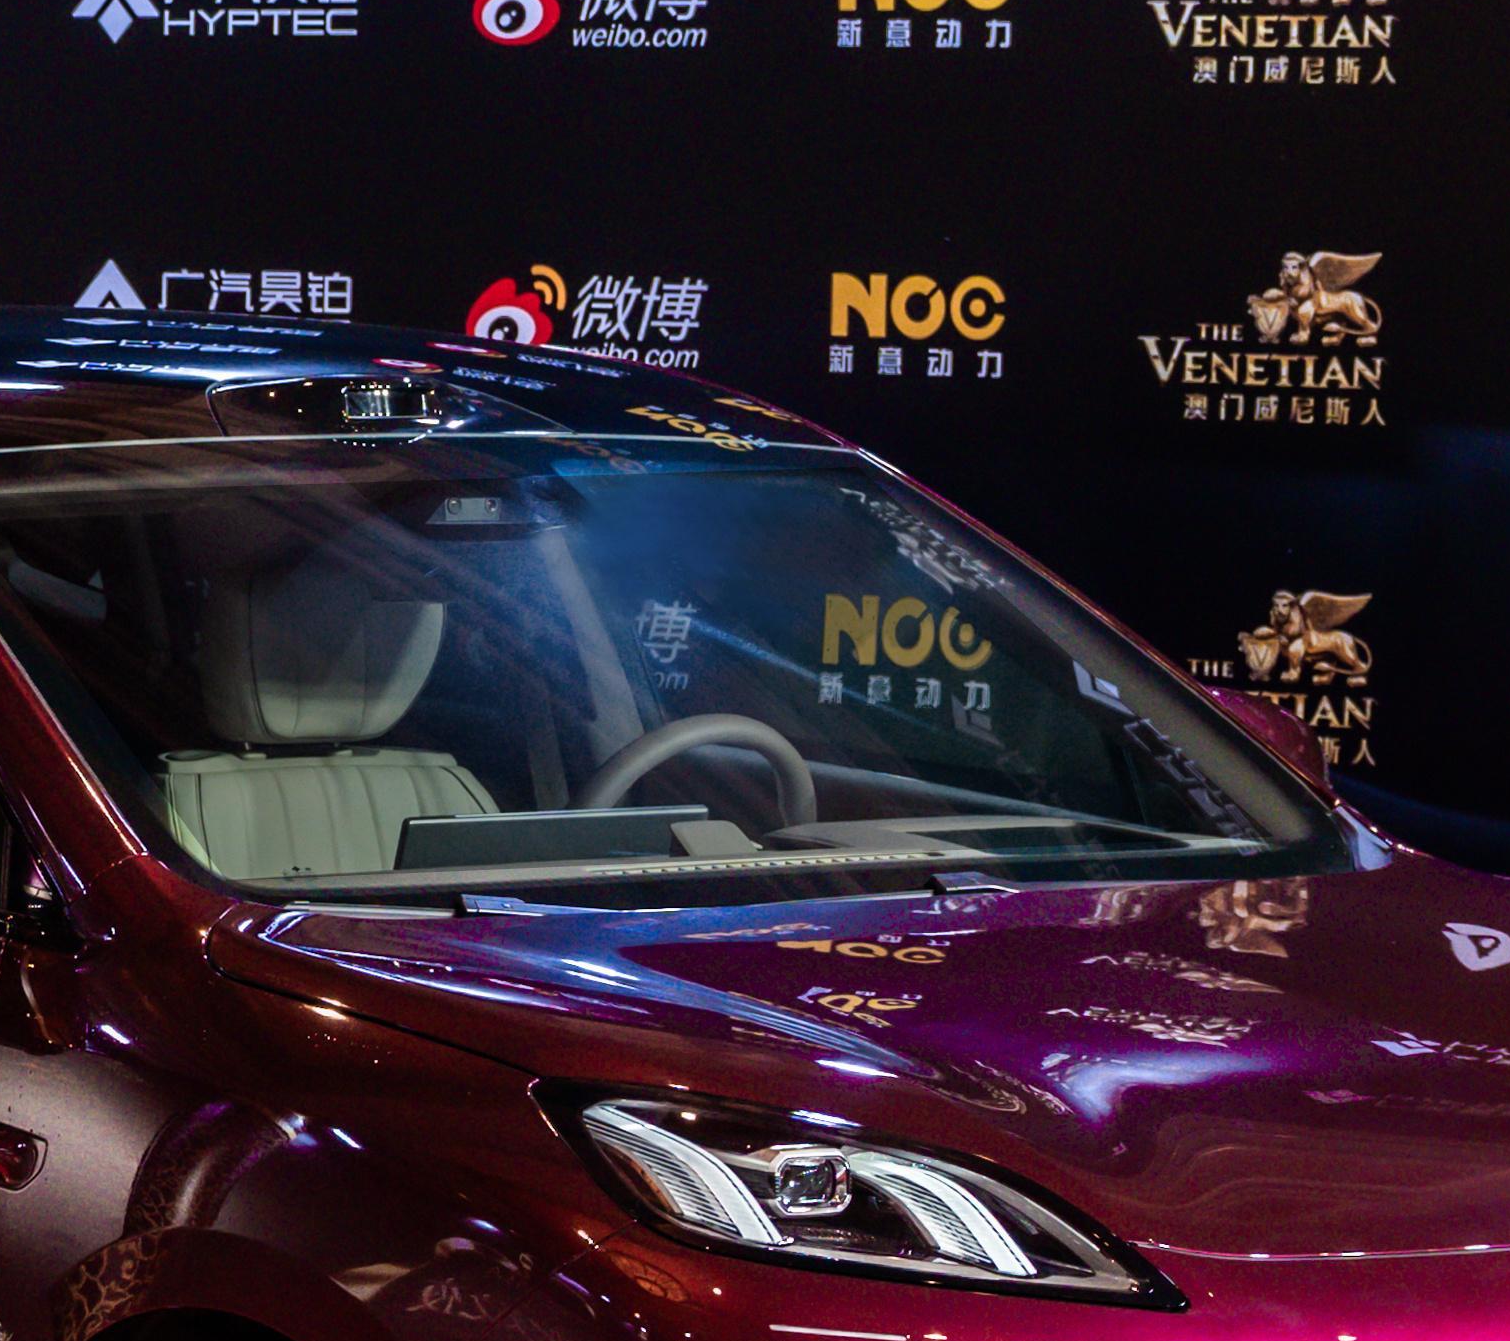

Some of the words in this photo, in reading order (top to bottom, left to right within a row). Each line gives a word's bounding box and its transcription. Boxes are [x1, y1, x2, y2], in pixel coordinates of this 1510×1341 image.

[164, 9, 358, 36] HYPTEC
[573, 24, 707, 47] weibo.com
[837, 19, 1011, 48] 新意动力
[1193, 56, 1395, 84] 澳门威尼斯人
[158, 269, 352, 318] 广汽昊铂
[573, 276, 708, 341] 微博
[831, 273, 1005, 340] NOC
[830, 345, 1002, 378] 新意动力
[1139, 336, 1383, 388] VENETIAN
